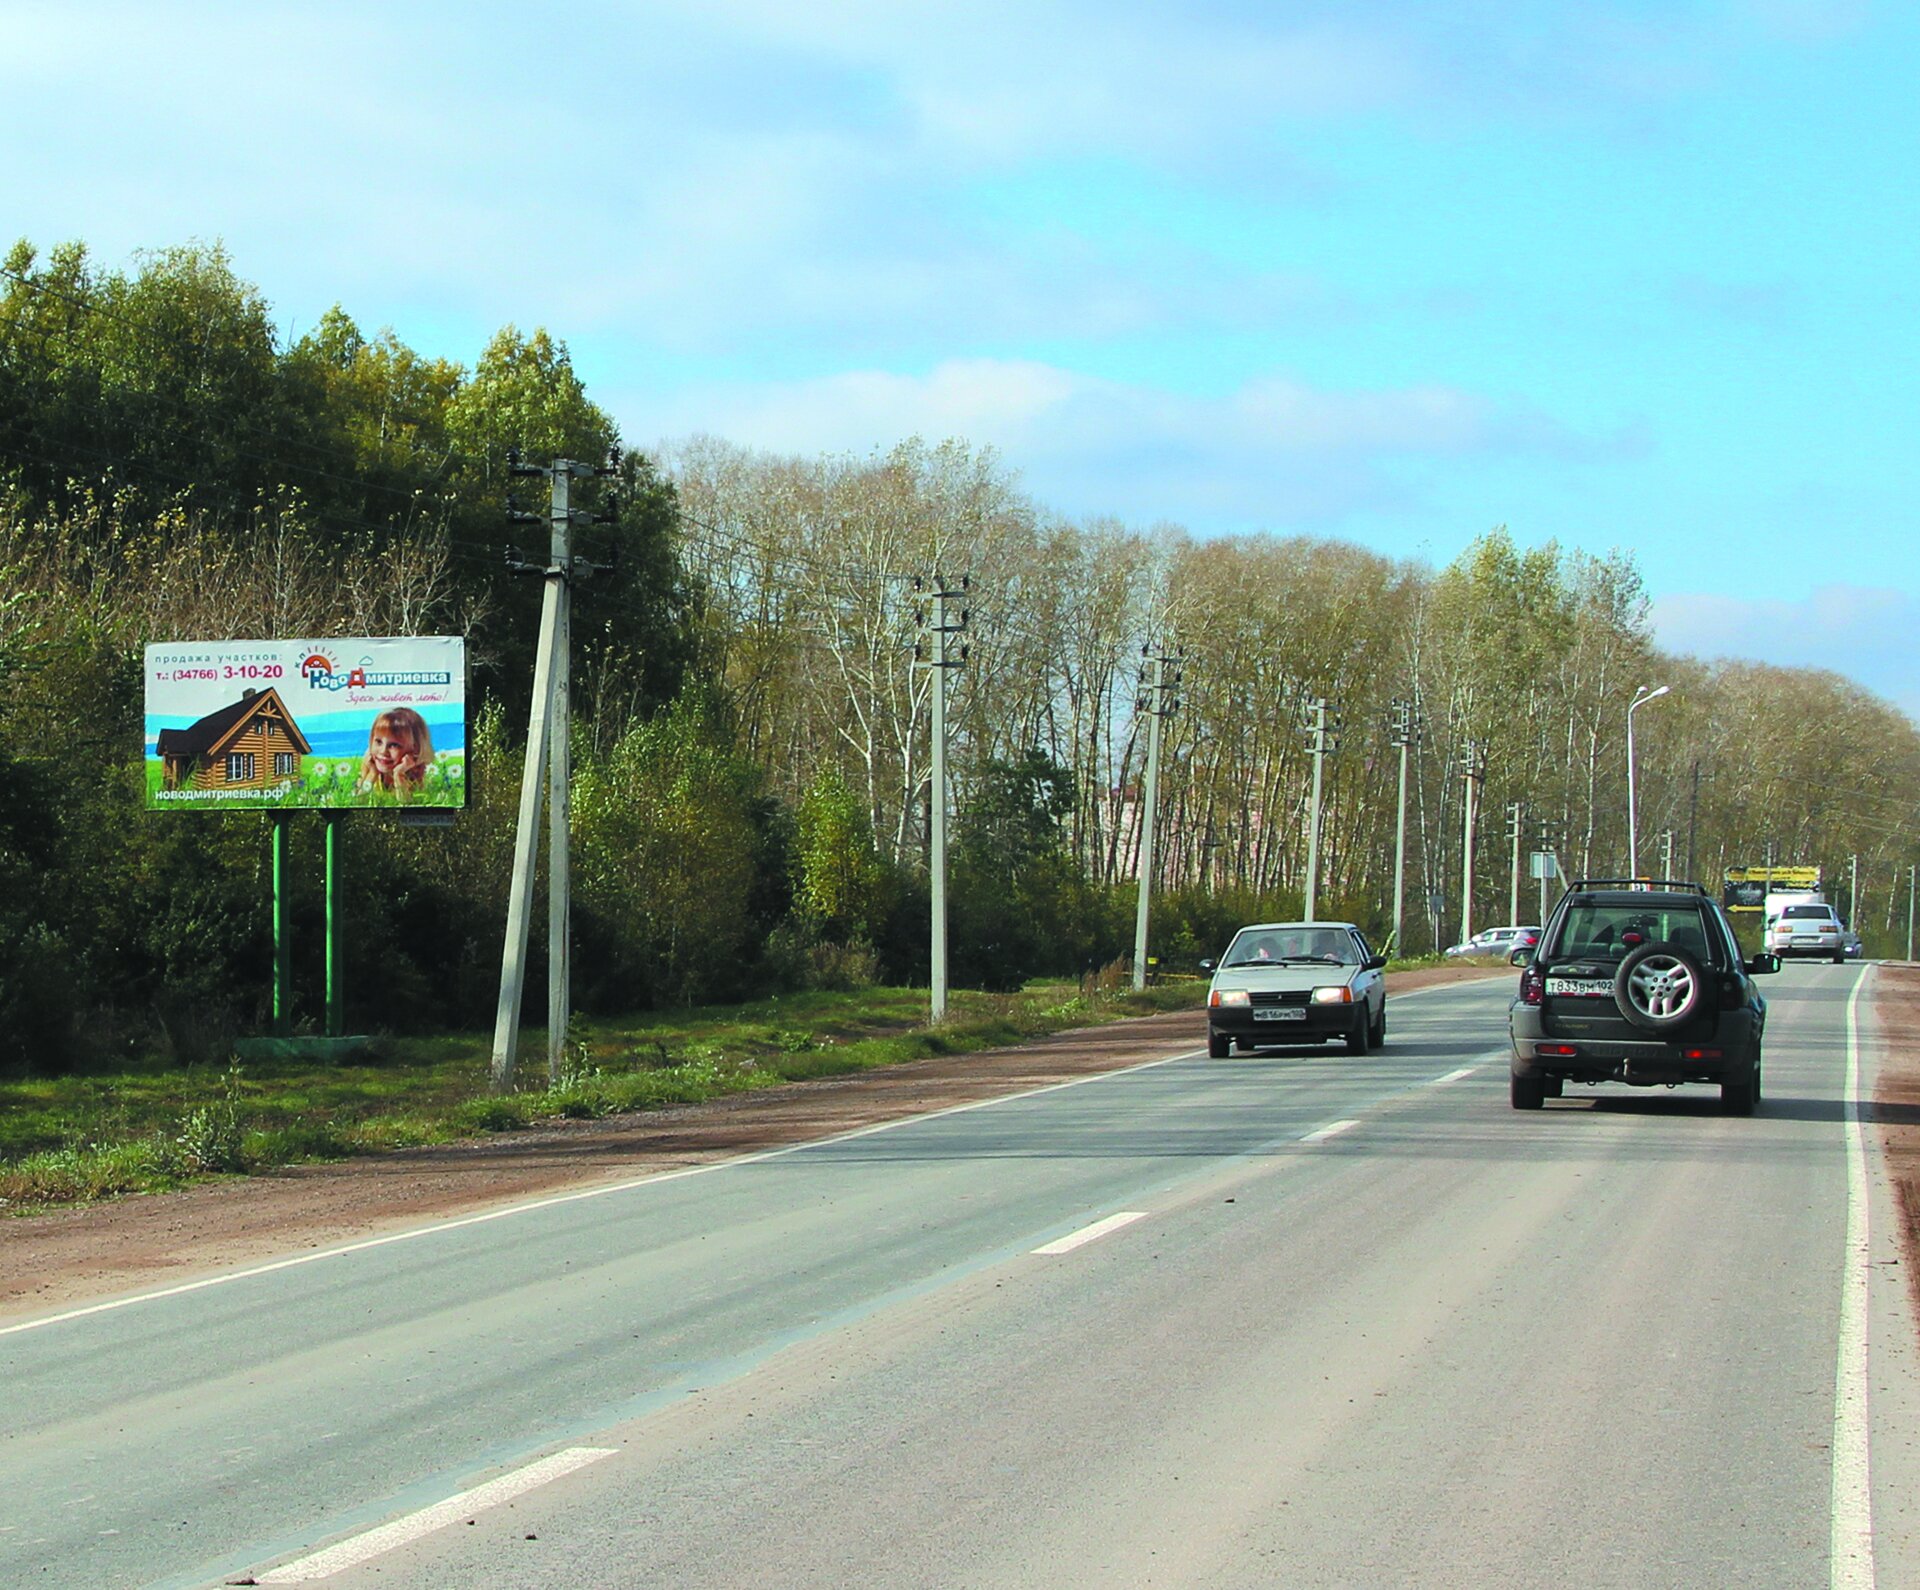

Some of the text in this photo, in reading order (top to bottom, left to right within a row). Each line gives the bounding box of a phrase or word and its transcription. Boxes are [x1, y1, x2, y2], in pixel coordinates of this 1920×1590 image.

[155, 653, 283, 664] продажа участков:
[172, 669, 218, 681] (34766)
[223, 664, 283, 678] 3-10-20
[345, 690, 374, 705] Здесь
[155, 787, 284, 801] новодмитриевка.рф
